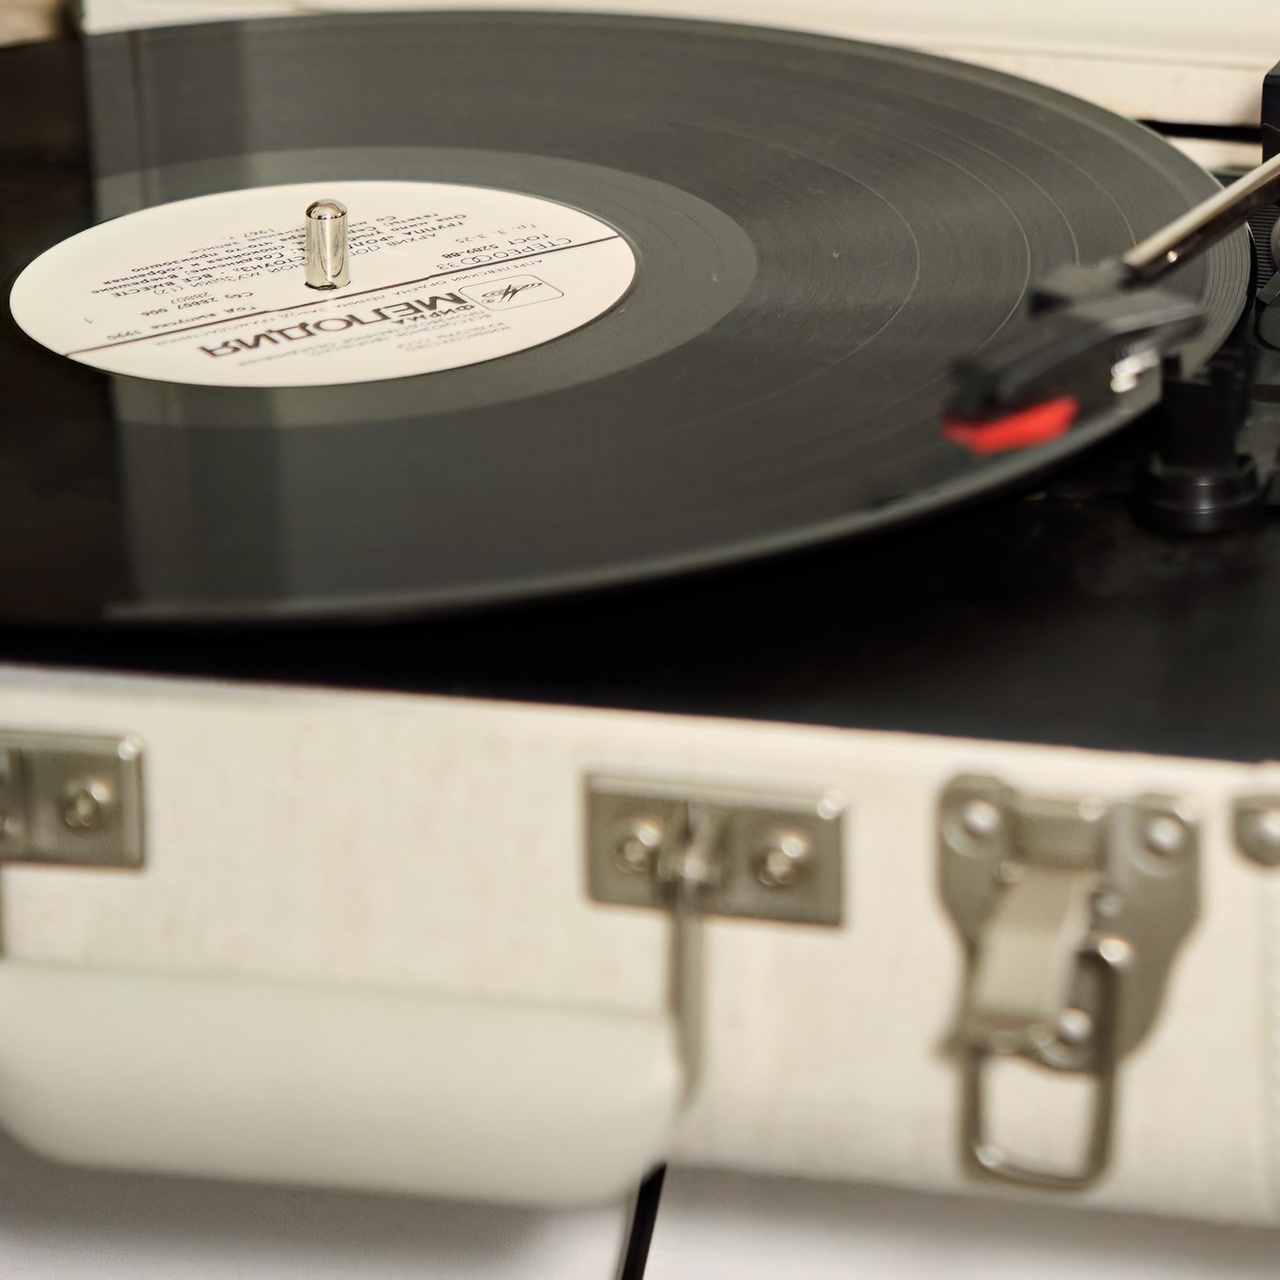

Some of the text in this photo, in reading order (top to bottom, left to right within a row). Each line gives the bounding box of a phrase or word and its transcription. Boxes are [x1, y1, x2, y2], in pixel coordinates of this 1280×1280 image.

[401, 221, 464, 237] ГРУППА
[508, 234, 550, 245] ГОСТ
[493, 238, 572, 259] СТЕРЕО
[182, 273, 213, 283] ВСЕ
[111, 281, 176, 297] ВМЕСТЕ
[390, 305, 476, 325] ФИРМА
[196, 293, 470, 359] МЕЛОДИЯ
